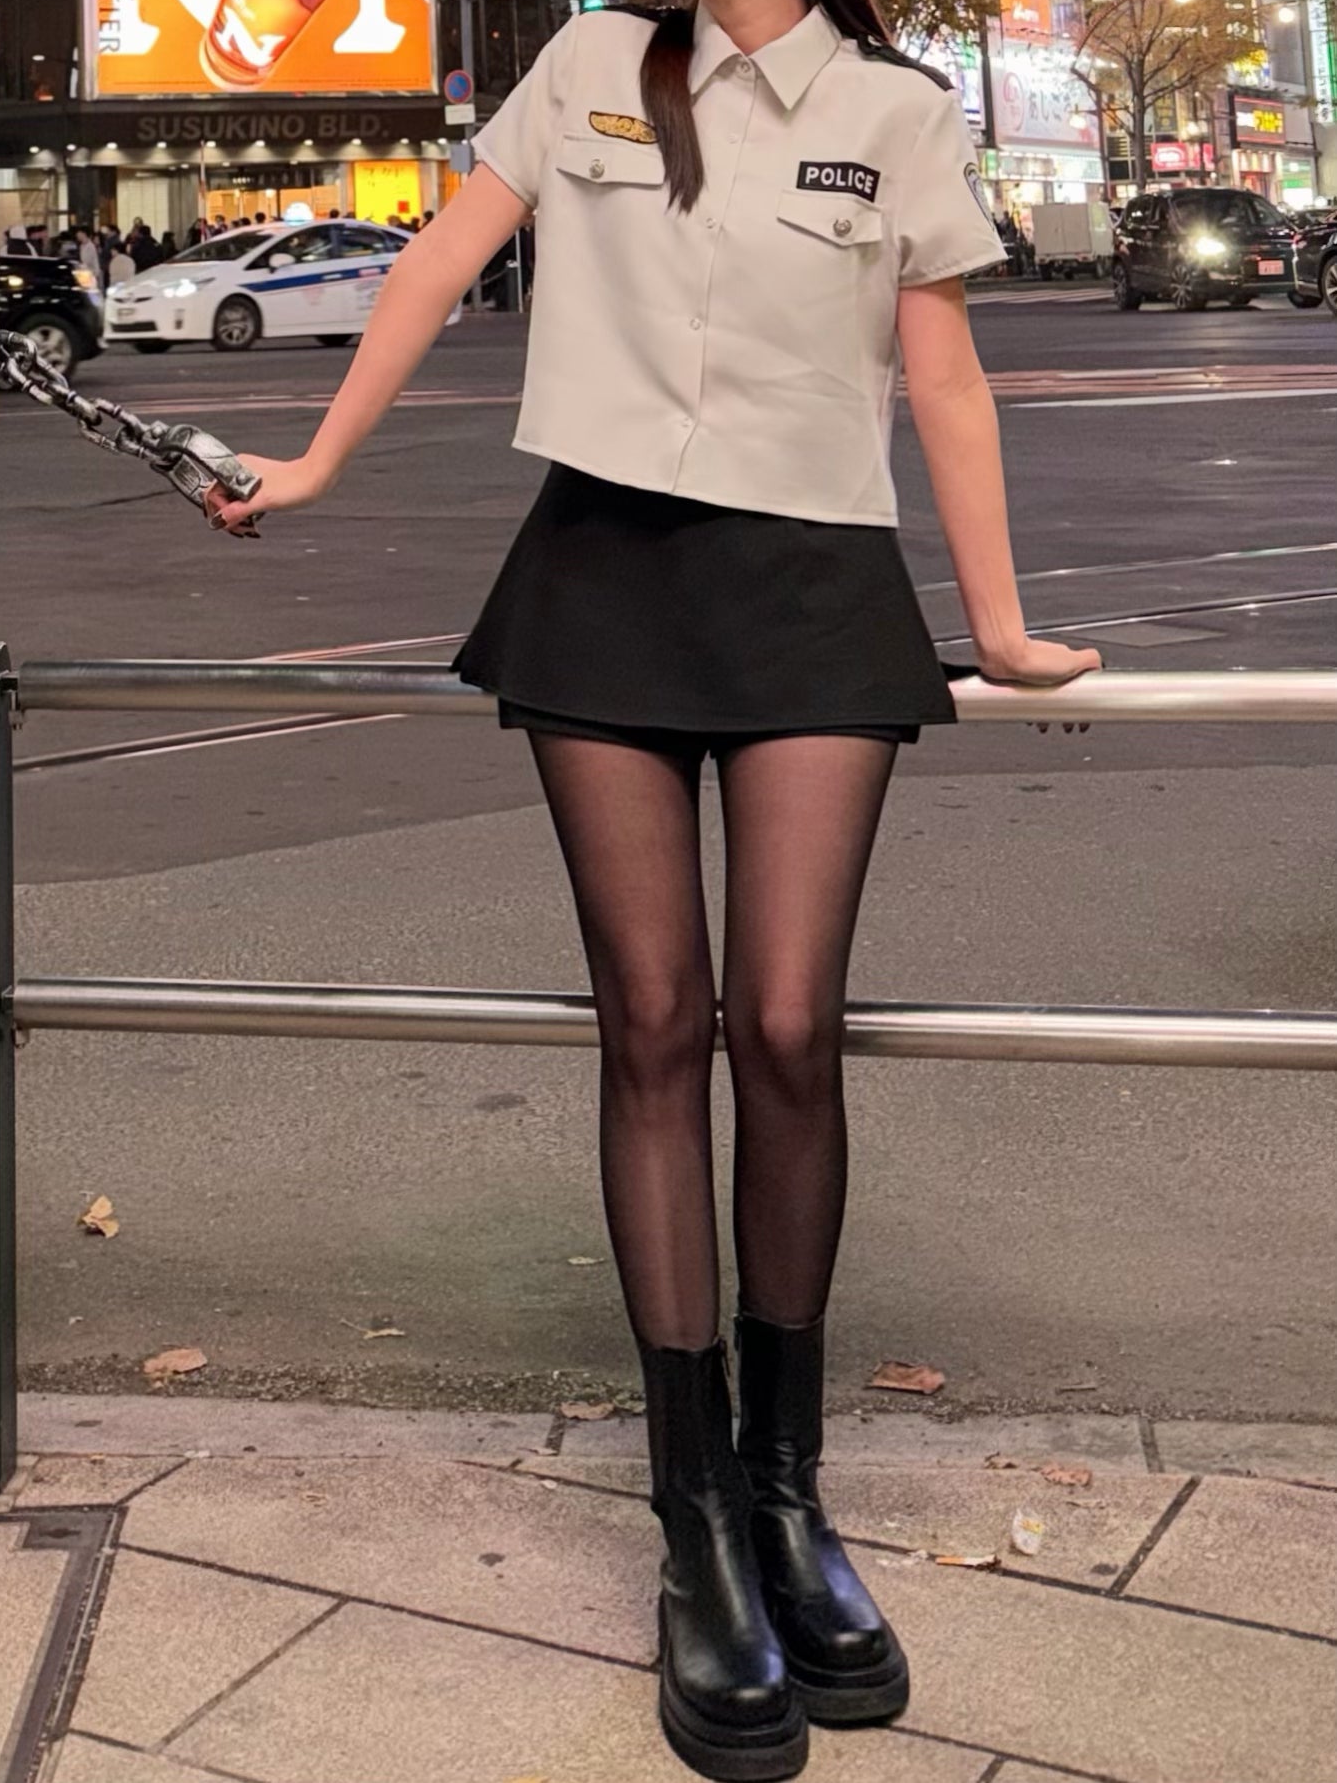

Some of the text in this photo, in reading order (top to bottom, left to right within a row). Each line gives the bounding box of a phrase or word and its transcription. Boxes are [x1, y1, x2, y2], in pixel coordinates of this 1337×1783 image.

[135, 113, 392, 142] SUSUKINO BLD.
[804, 166, 875, 196] POLICE
